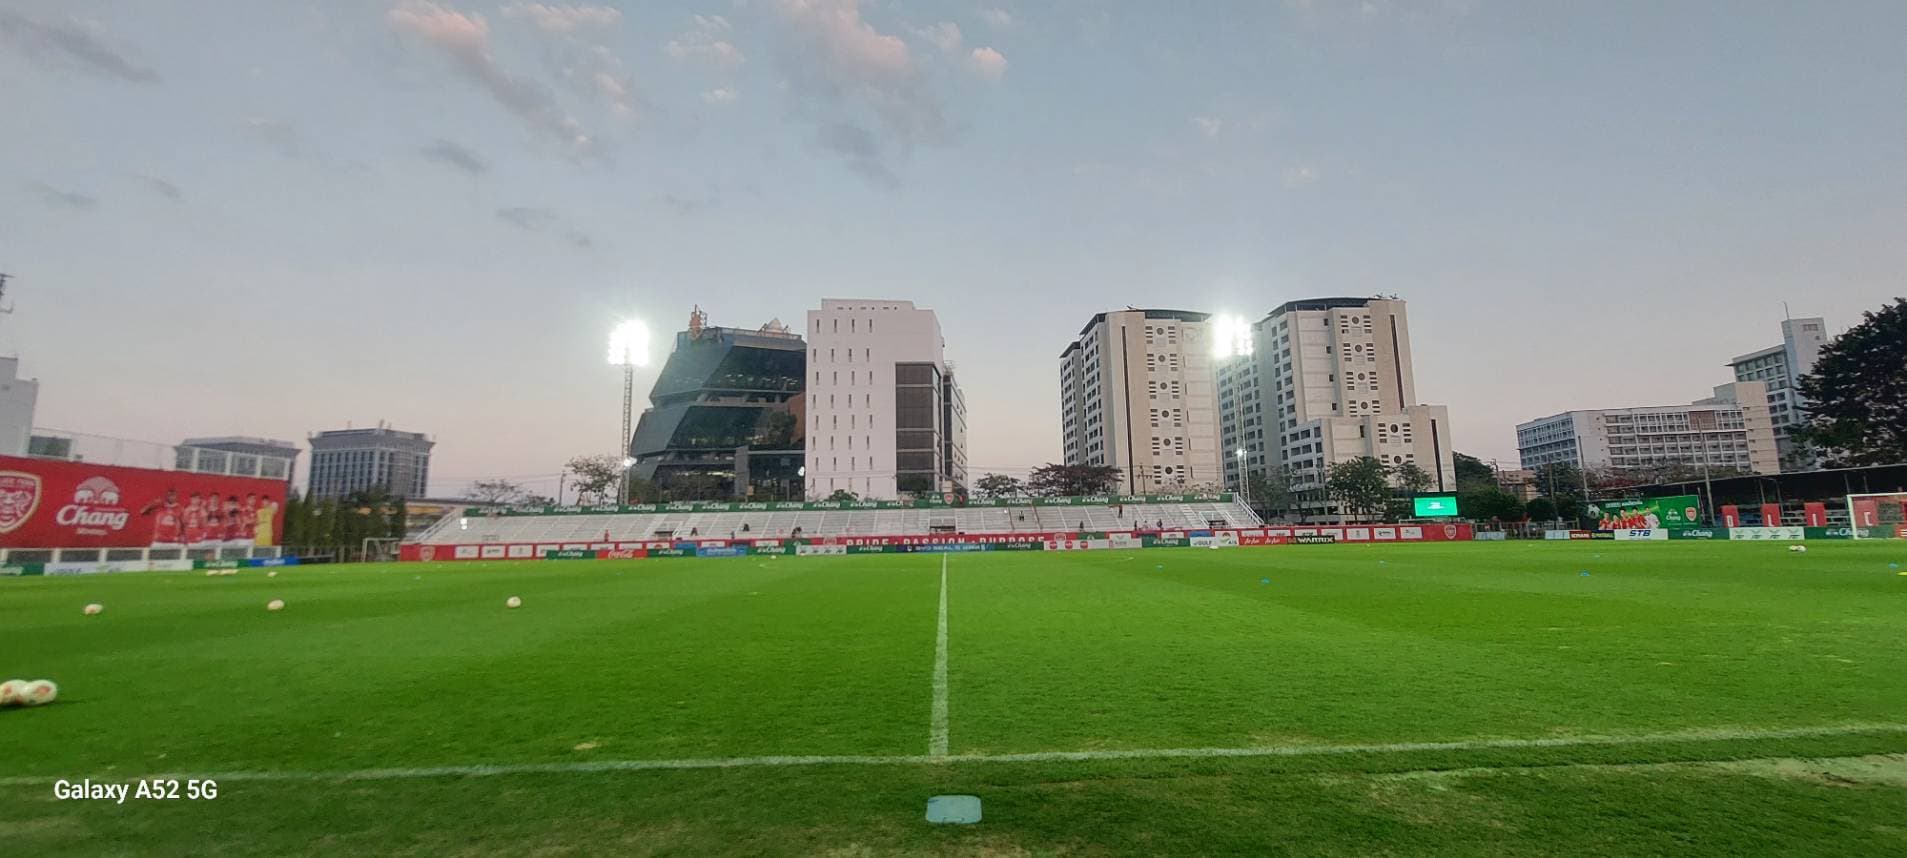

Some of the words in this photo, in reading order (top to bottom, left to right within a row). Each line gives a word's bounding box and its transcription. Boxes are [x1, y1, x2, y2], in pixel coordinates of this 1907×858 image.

[56, 504, 130, 530] Chang
[1629, 529, 1652, 537] STB
[1691, 529, 1713, 538] Chang
[846, 538, 889, 546] PRIDE
[903, 537, 965, 545] PASSION
